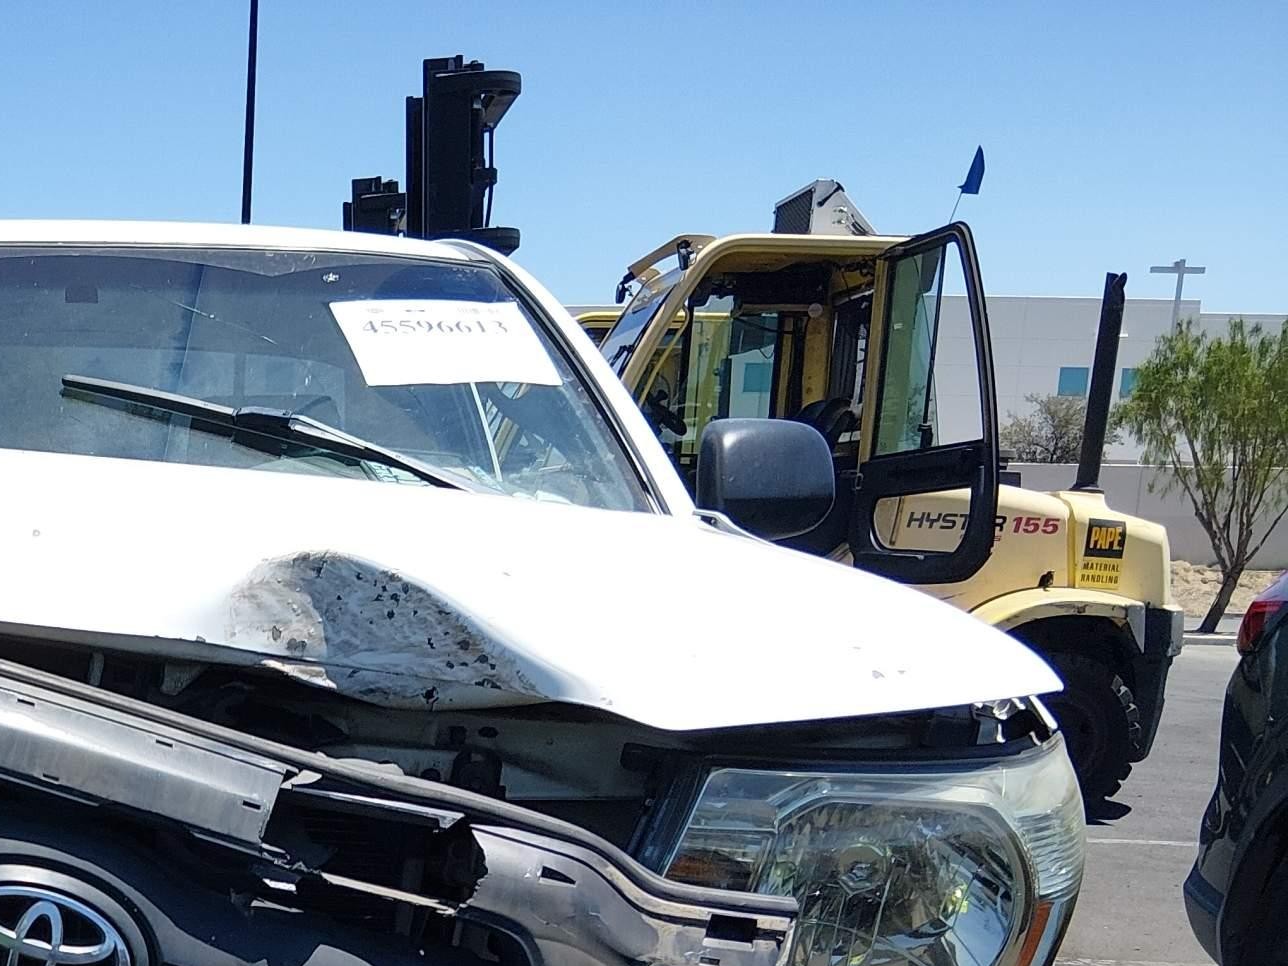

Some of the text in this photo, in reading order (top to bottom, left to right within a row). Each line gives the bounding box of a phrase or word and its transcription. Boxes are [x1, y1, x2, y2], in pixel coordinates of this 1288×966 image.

[362, 320, 508, 334] 45596613
[906, 511, 1061, 535] HYSTR 155
[1082, 561, 1120, 573] MATERIAL
